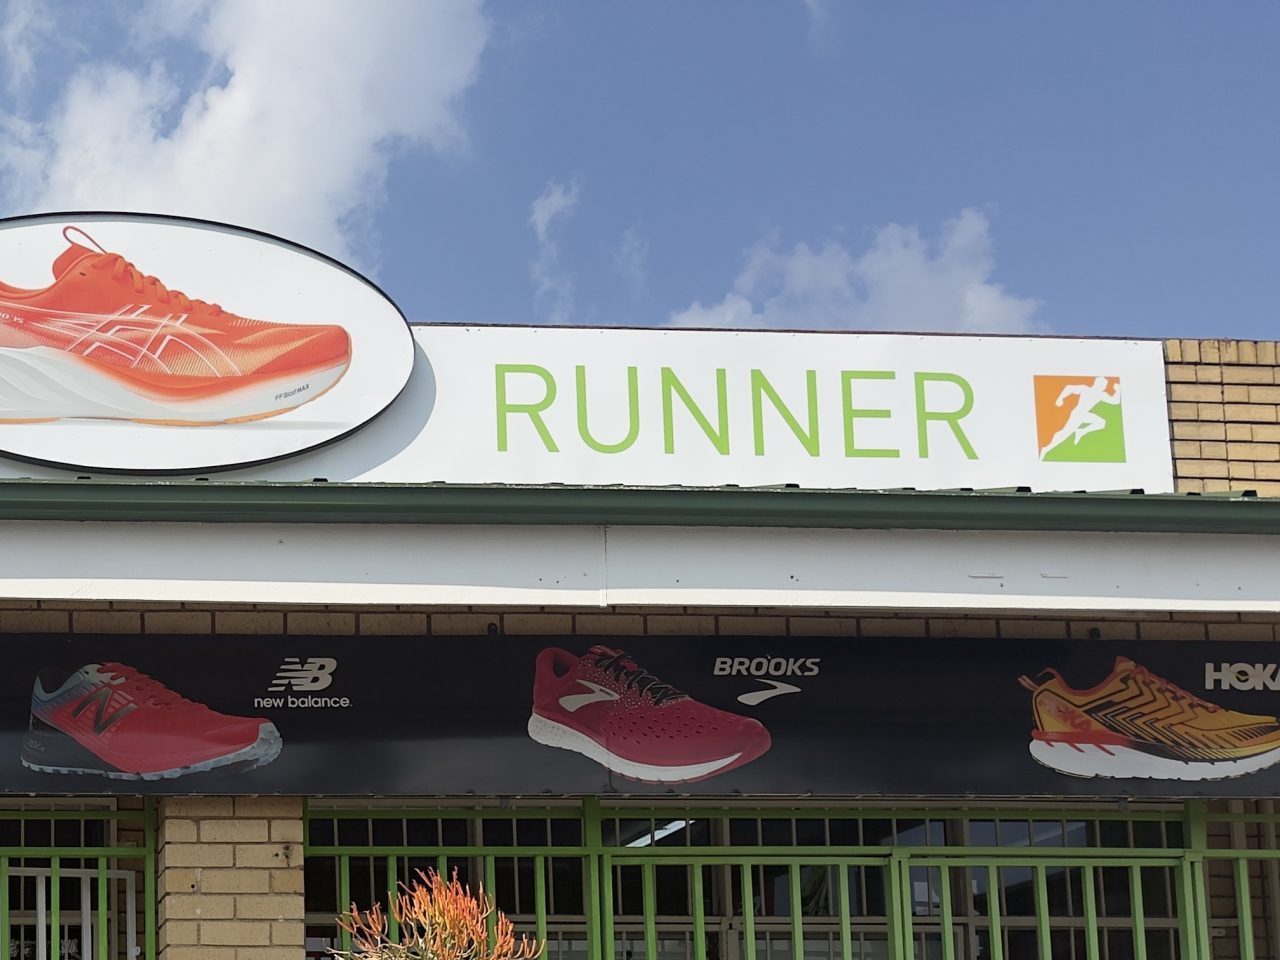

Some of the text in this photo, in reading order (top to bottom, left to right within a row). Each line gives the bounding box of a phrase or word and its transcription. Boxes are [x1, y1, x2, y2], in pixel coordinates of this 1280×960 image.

[494, 364, 979, 460] RUNNER
[713, 657, 822, 677] BROOKS
[254, 695, 350, 708] new balance
